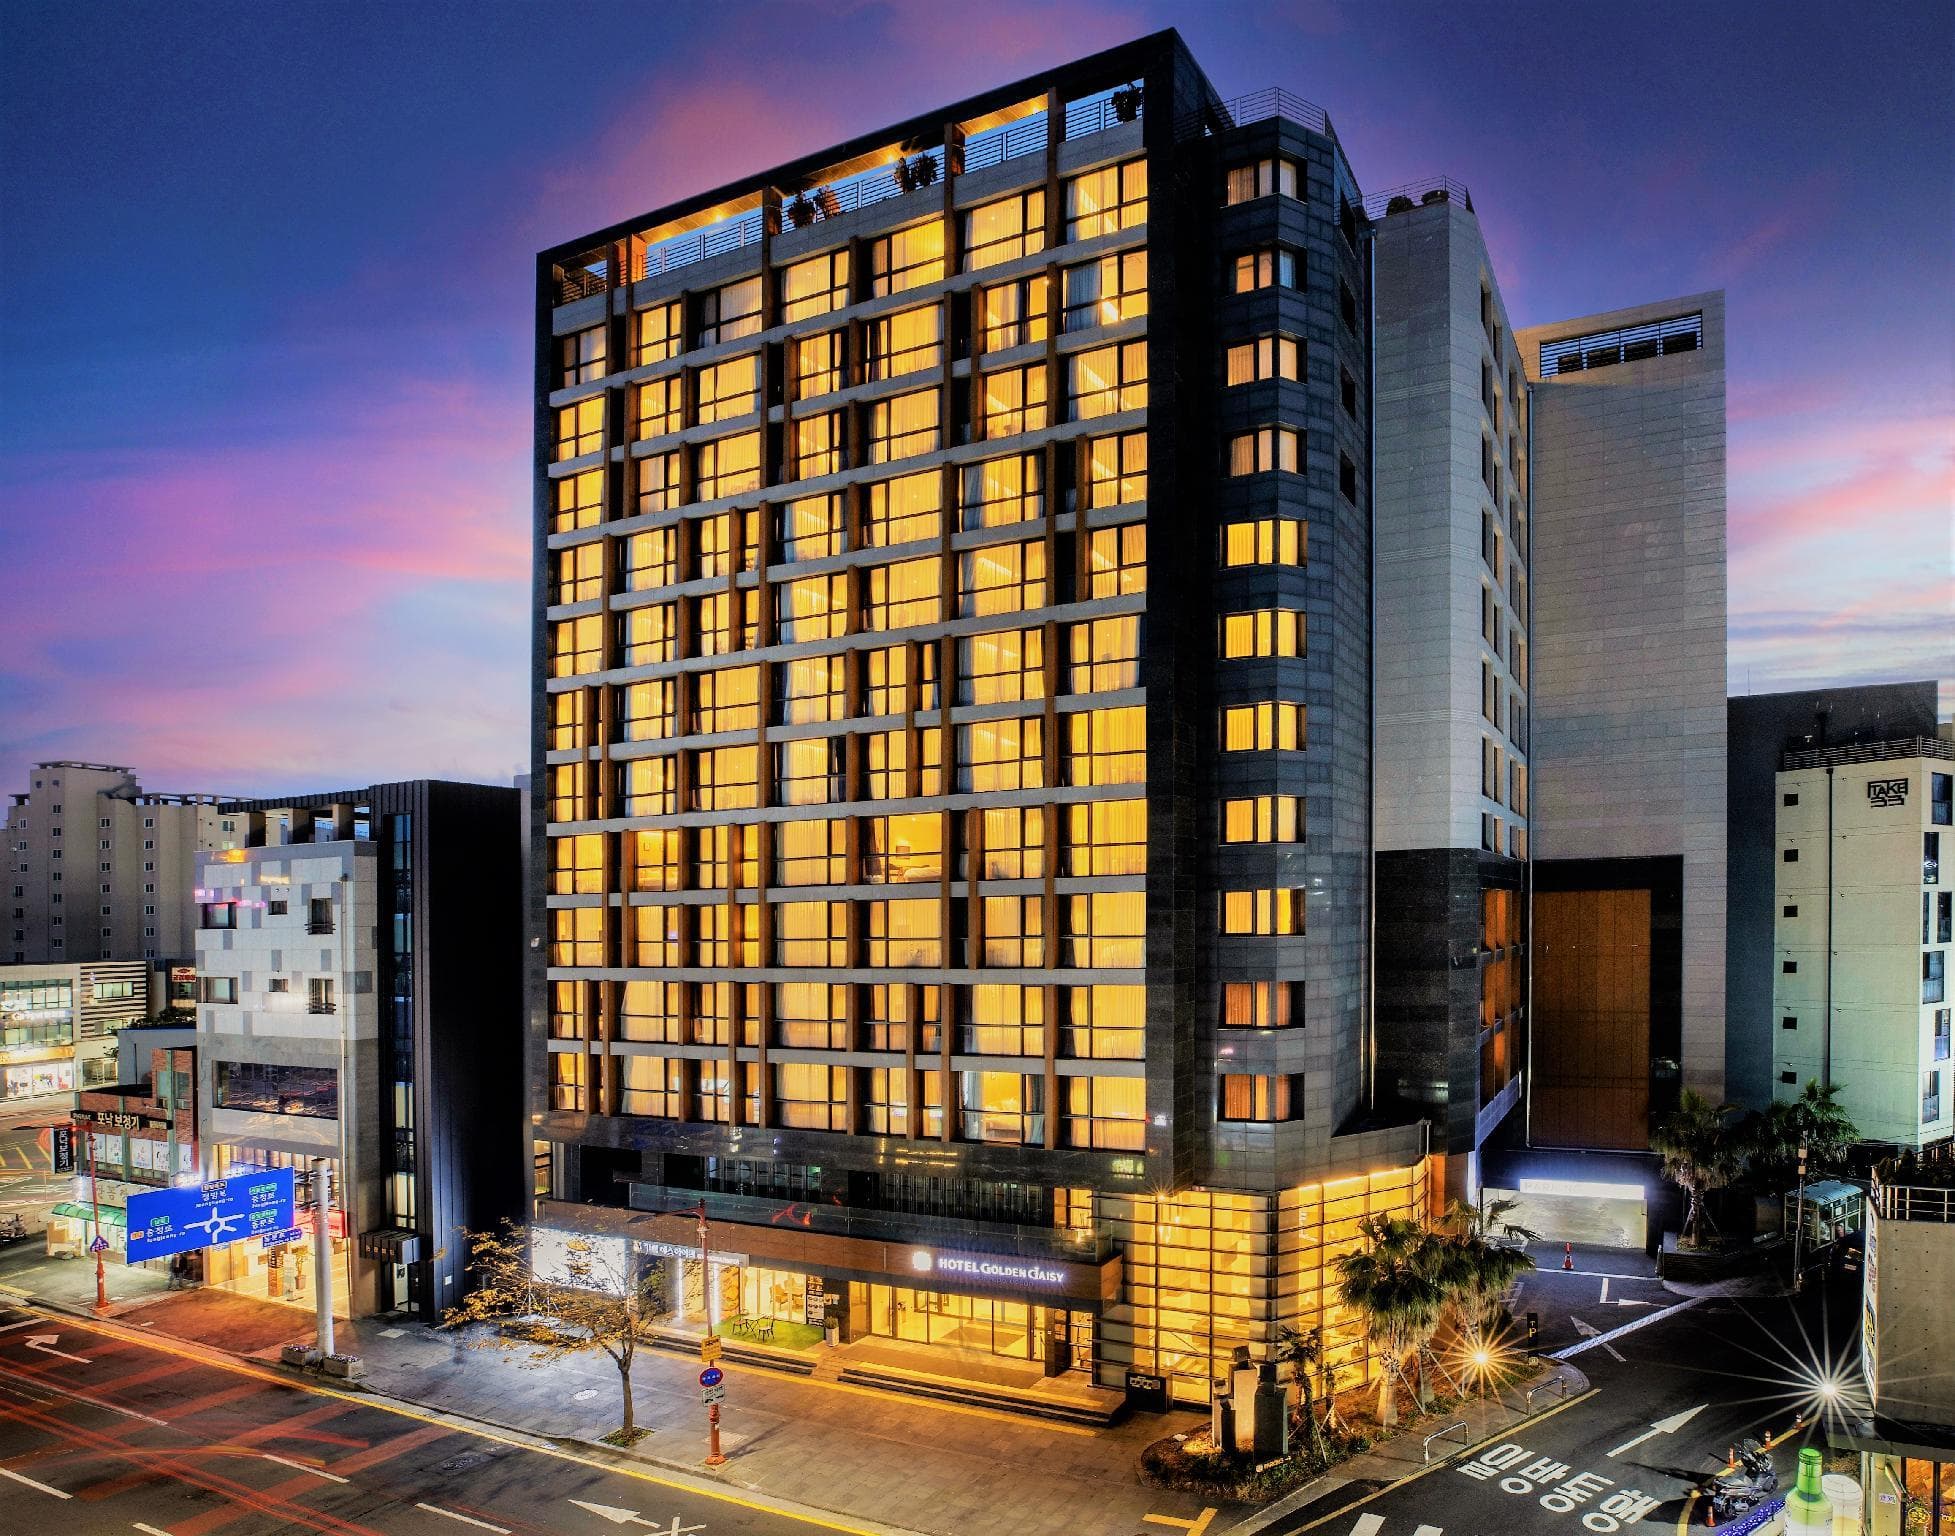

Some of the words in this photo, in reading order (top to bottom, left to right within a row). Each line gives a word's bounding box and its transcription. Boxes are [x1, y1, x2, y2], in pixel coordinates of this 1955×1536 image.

[114, 1114, 140, 1131] 보청기
[939, 1258, 981, 1273] HOTEL
[980, 1263, 1027, 1278] GOLDEN
